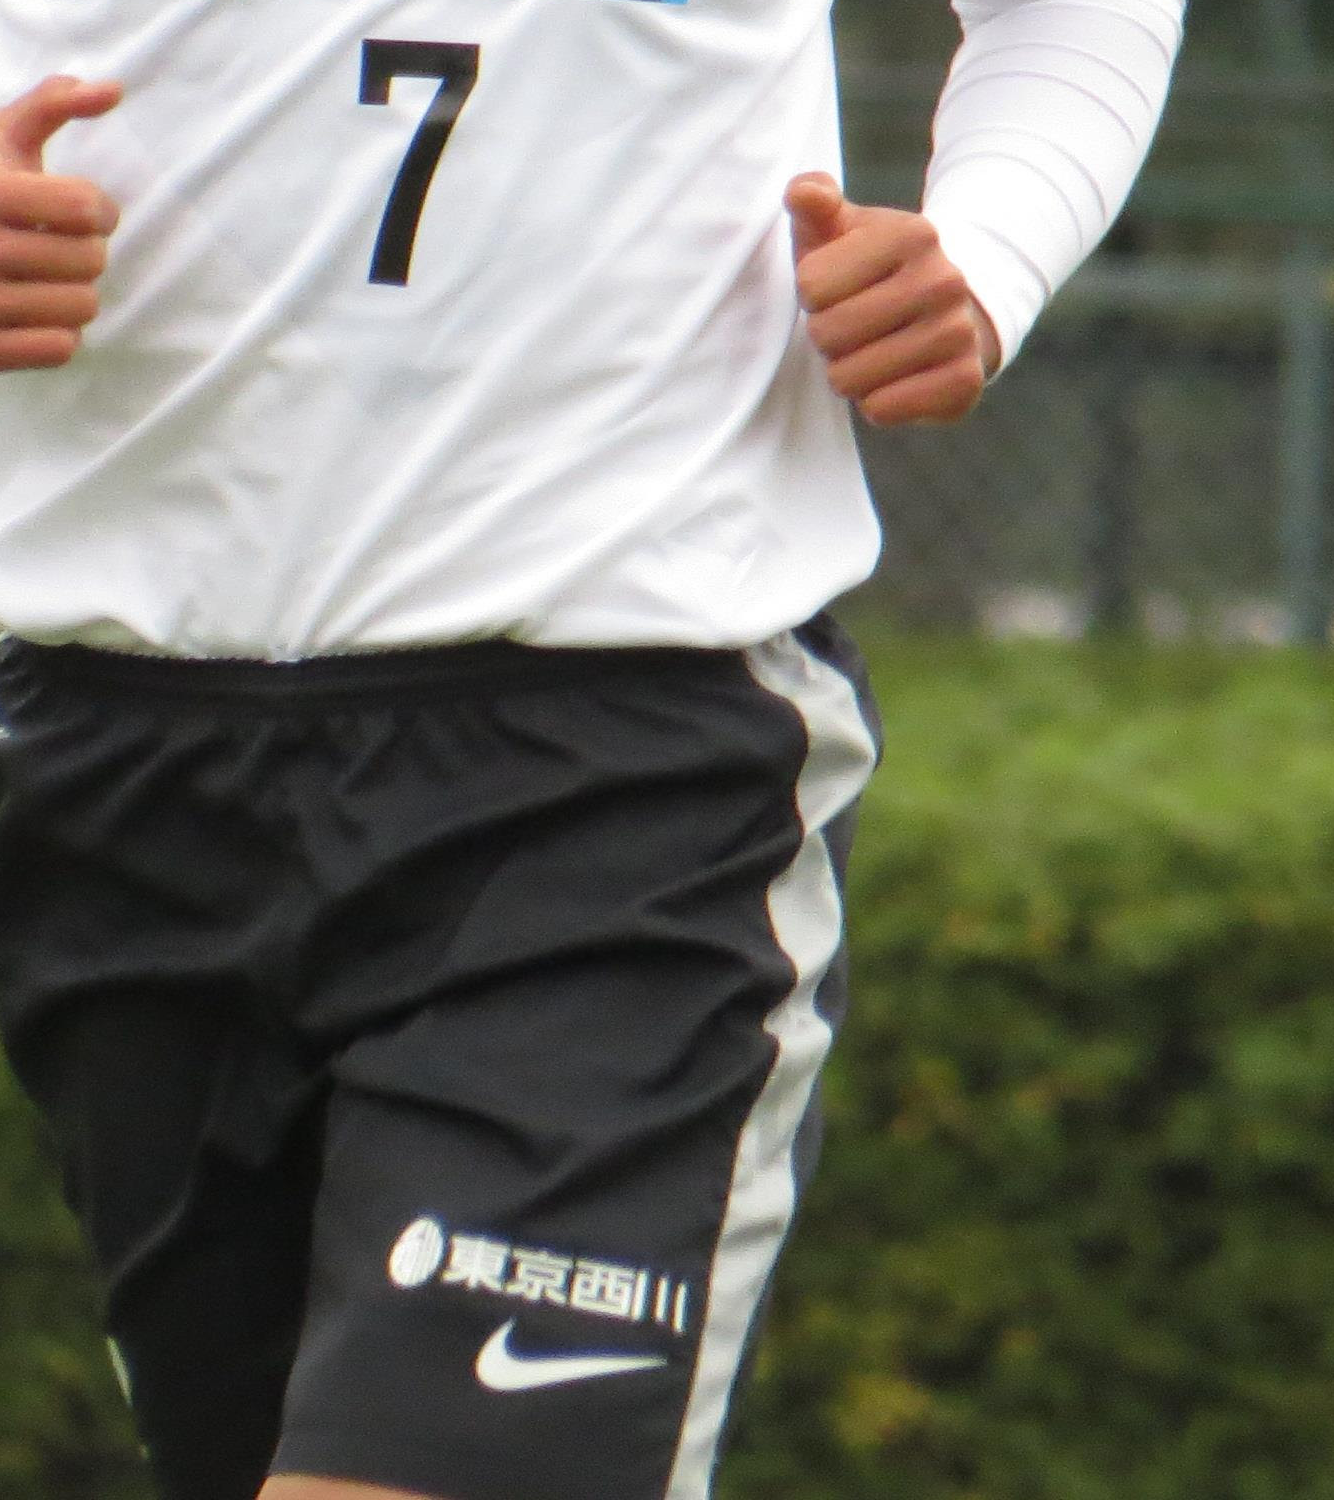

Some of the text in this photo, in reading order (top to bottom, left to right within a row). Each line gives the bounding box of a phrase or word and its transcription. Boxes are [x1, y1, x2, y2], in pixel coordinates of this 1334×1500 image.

[358, 38, 481, 287] 7
[442, 1233, 689, 1336] 東京西川
